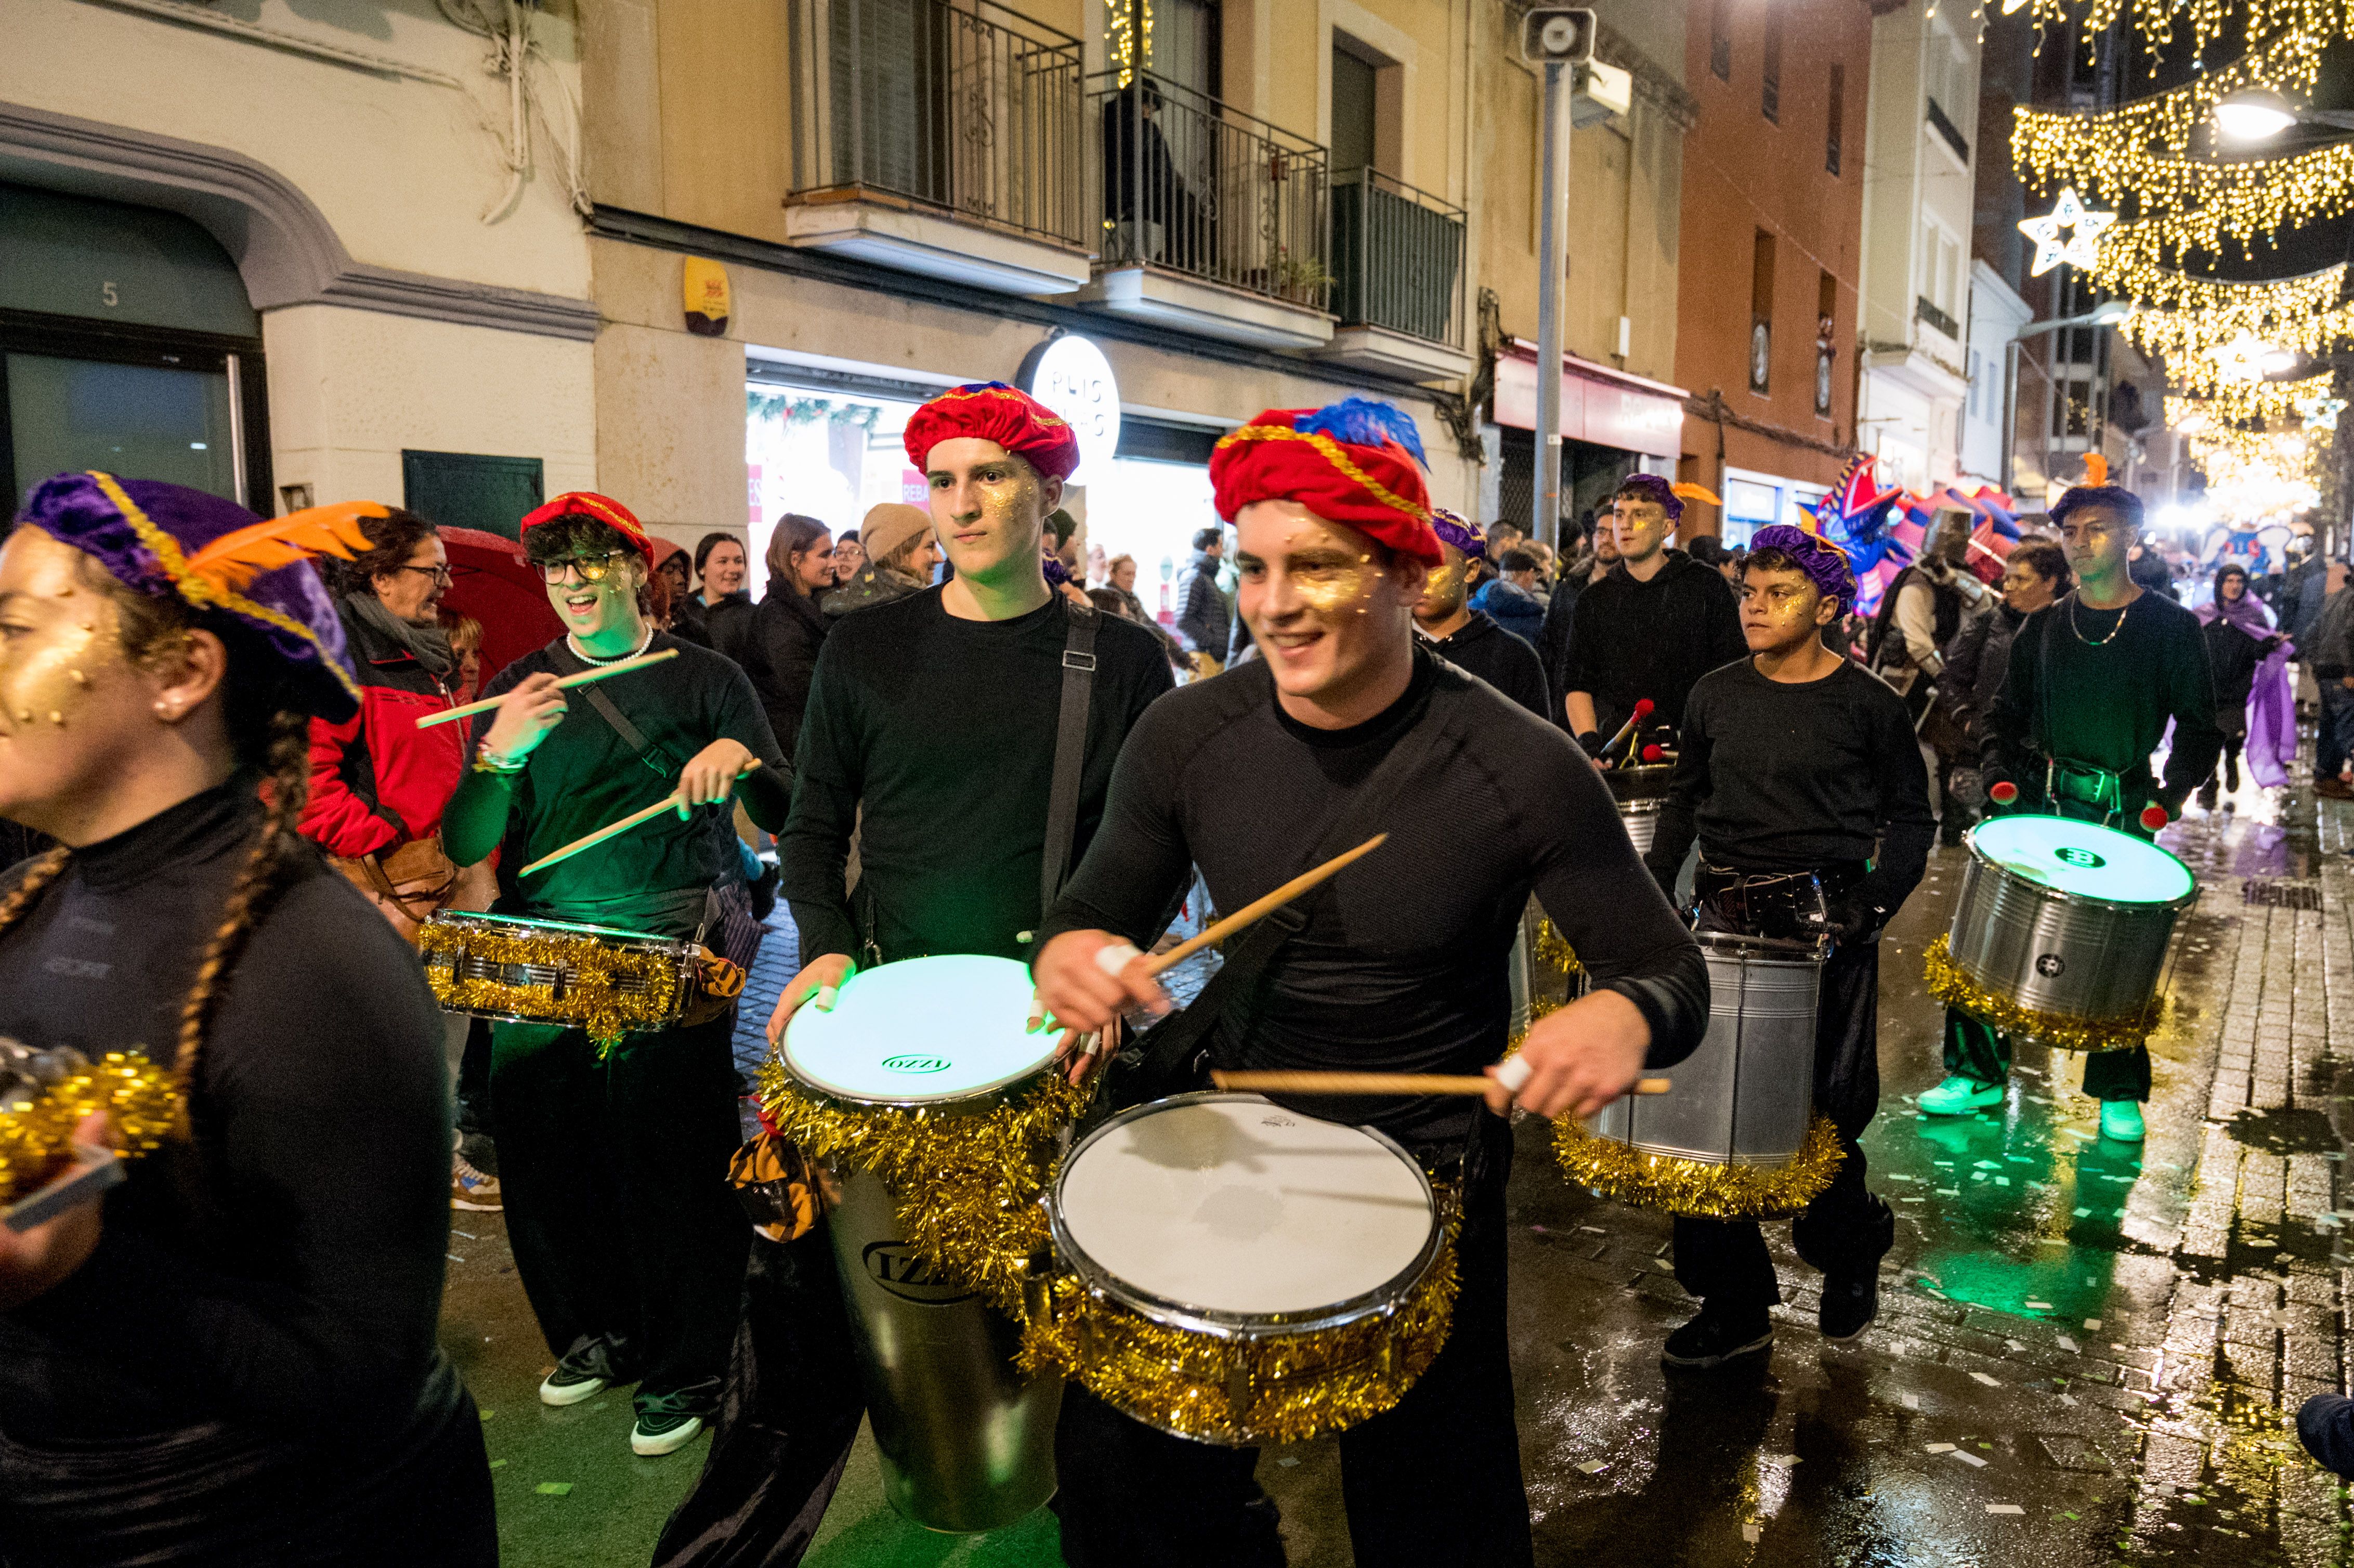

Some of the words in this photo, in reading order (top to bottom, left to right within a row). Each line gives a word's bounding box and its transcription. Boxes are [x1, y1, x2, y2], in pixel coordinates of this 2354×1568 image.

[103, 281, 117, 307] 5
[1053, 371, 1101, 402] PLIS
[903, 484, 929, 502] REBA
